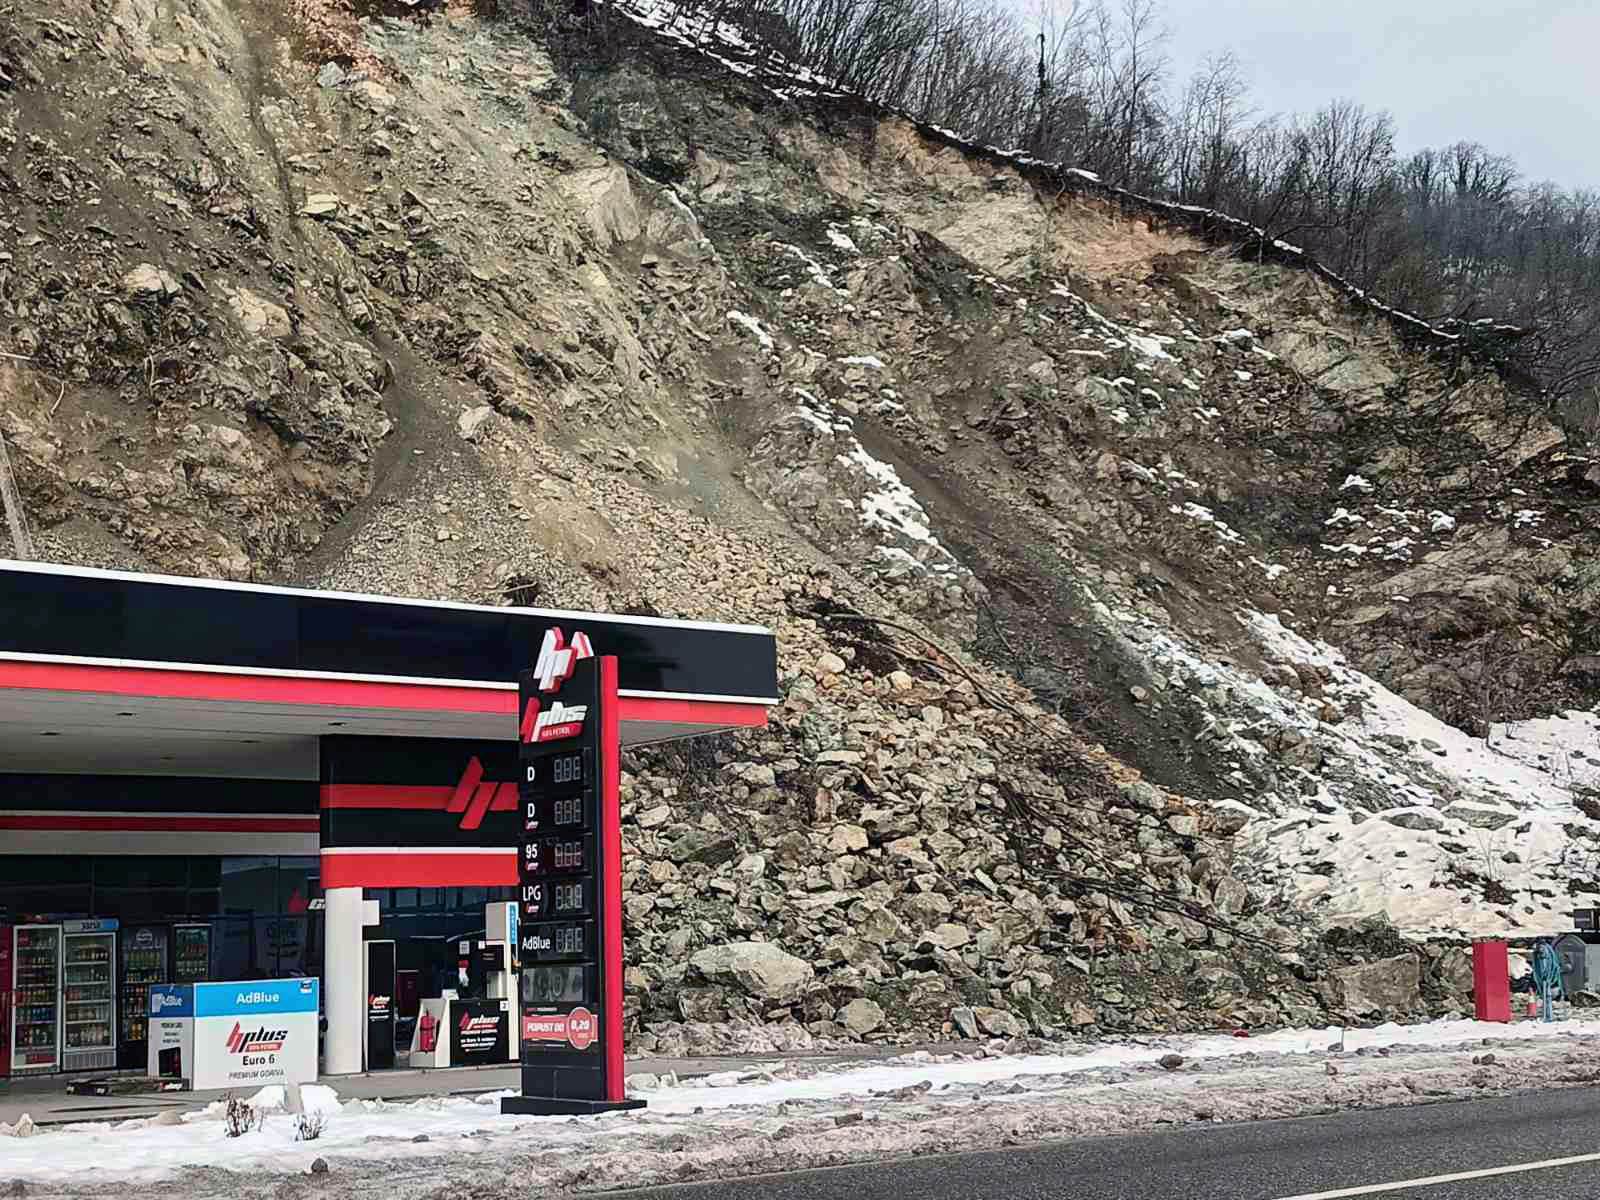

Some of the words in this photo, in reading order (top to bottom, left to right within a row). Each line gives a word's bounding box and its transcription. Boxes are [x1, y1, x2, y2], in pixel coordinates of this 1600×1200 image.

[527, 766, 535, 782] D
[527, 803, 535, 818] D
[525, 844, 538, 859] 95
[522, 885, 541, 902] LPG
[522, 936, 551, 950] AdBlue
[236, 992, 280, 1004] AdBlue
[243, 1056, 266, 1066] Euro
[269, 1055, 275, 1065] 6
[229, 1070, 259, 1080] PREMIUM
